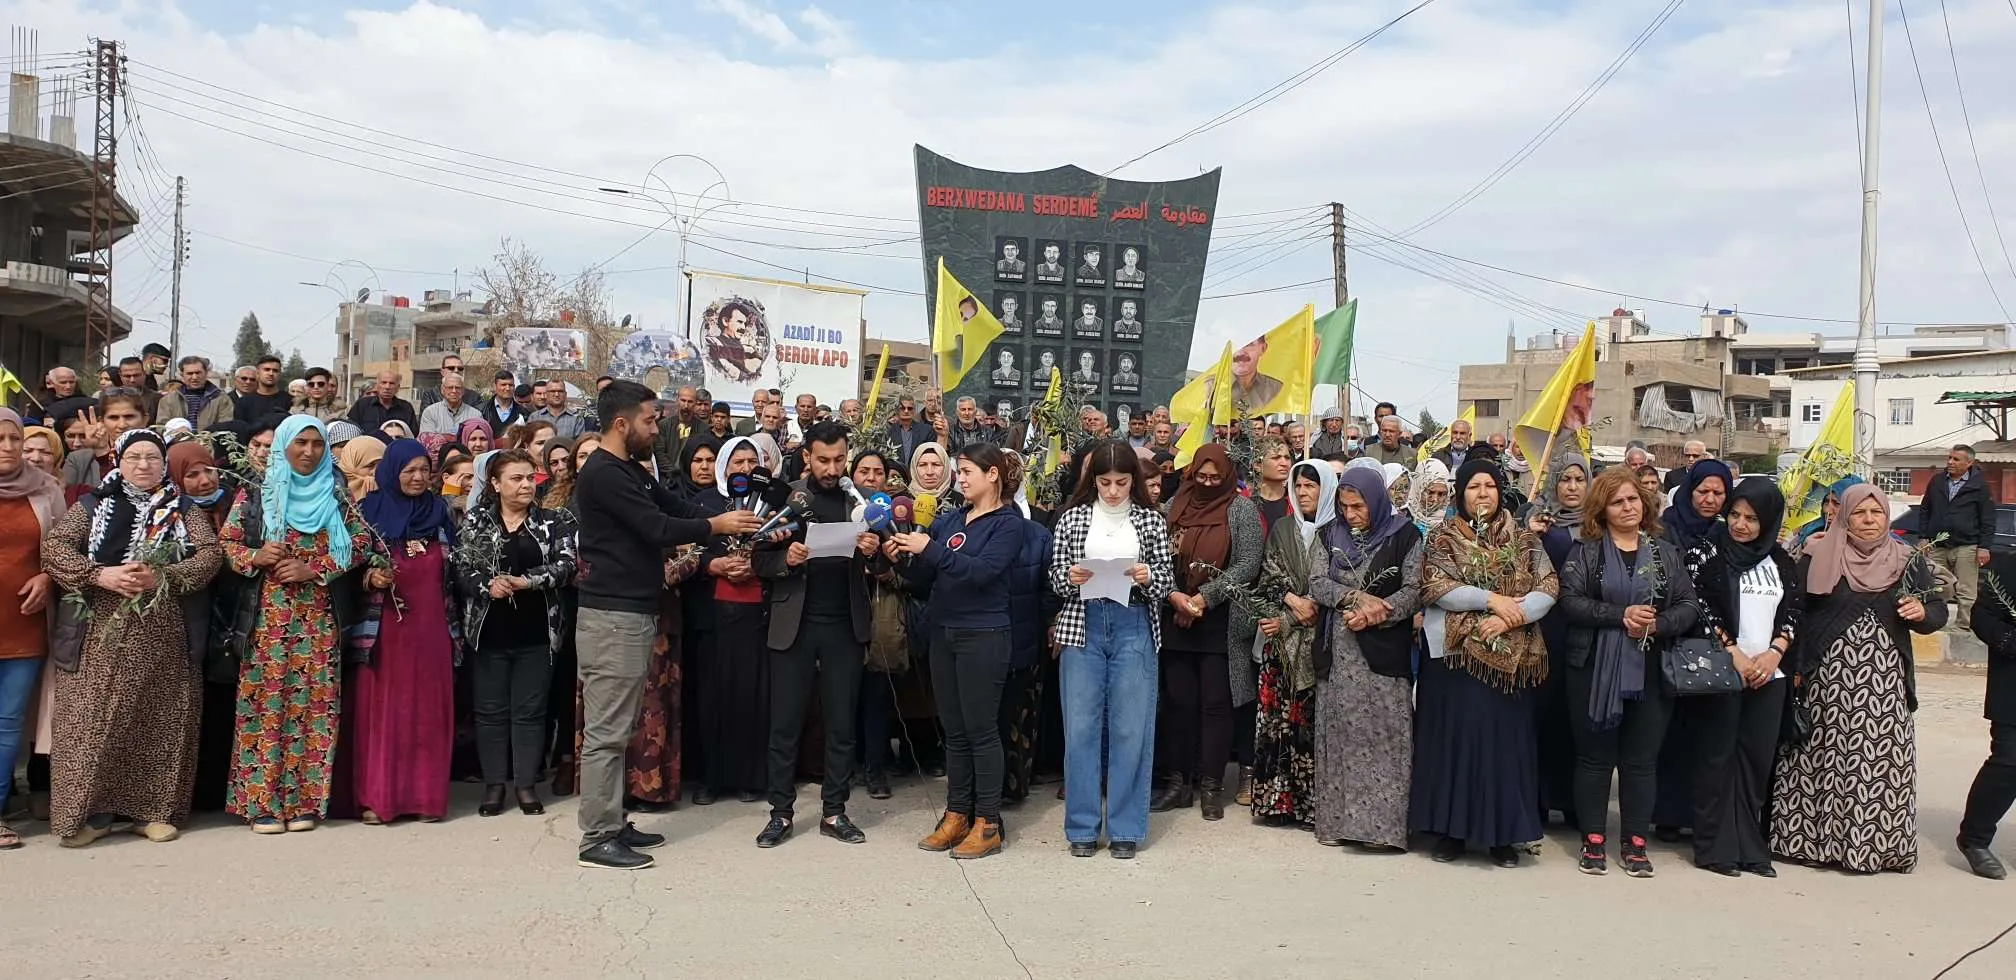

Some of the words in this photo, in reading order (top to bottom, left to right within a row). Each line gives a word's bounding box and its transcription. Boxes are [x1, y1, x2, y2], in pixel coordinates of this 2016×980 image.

[927, 186, 1025, 213] BERXWEDANA
[1032, 192, 1098, 218] SERDEMÊ
[1110, 201, 1149, 222] العصر
[1162, 203, 1207, 227] مقاومة
[783, 324, 815, 342] AZADÎ
[816, 328, 825, 343] JI
[827, 329, 842, 344] BO
[775, 344, 819, 366] SEROK
[821, 349, 848, 368] APO
